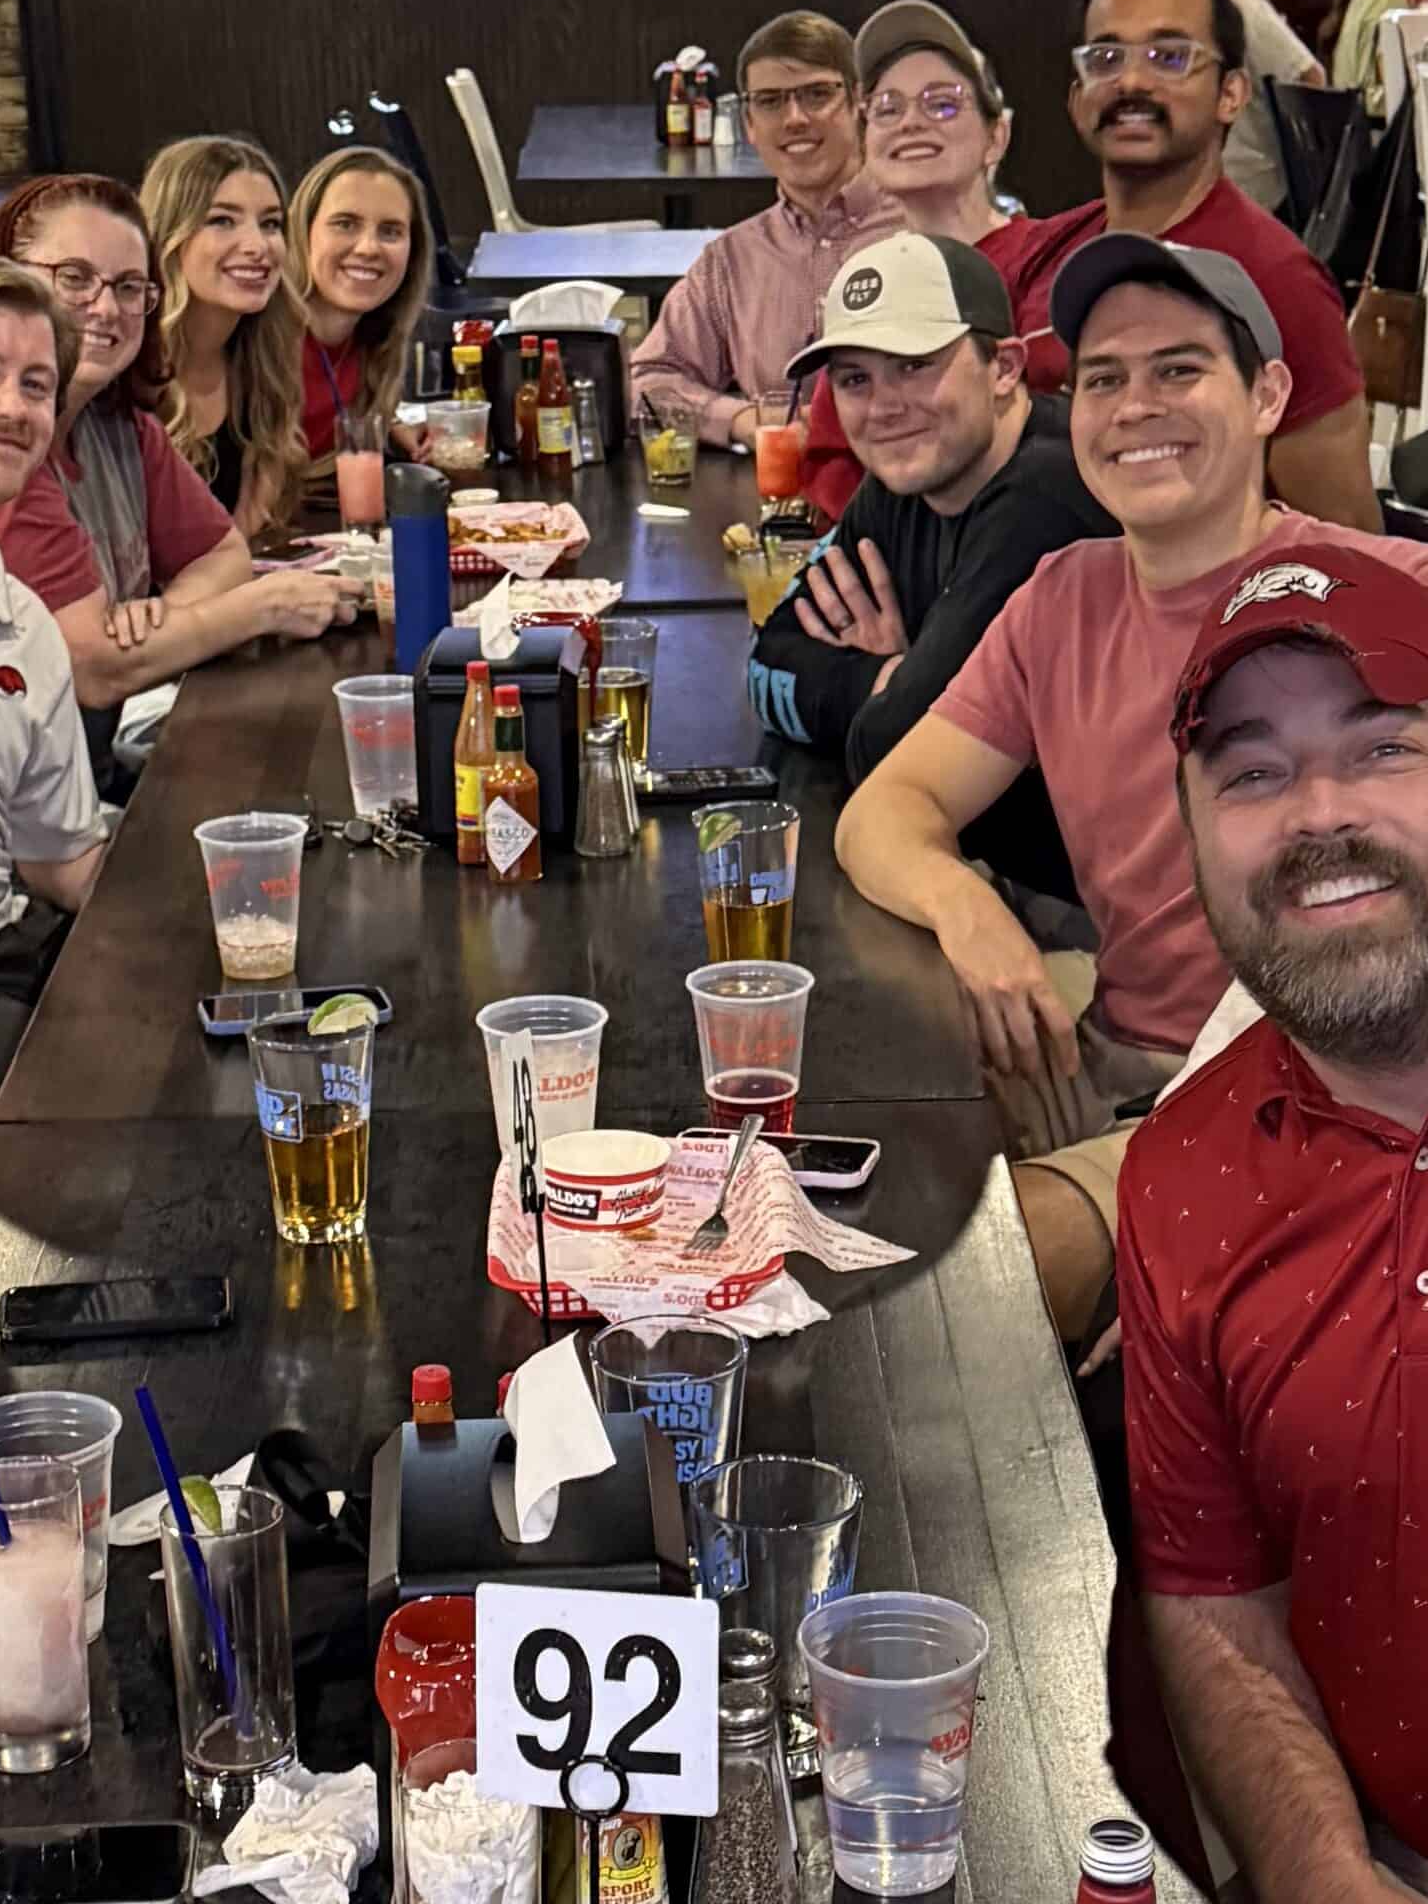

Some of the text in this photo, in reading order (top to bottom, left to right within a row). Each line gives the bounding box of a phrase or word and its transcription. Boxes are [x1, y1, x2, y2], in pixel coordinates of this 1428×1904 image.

[845, 277, 878, 294] FREE
[513, 1628, 681, 1776] 92
[601, 1877, 652, 1897] SPORT
